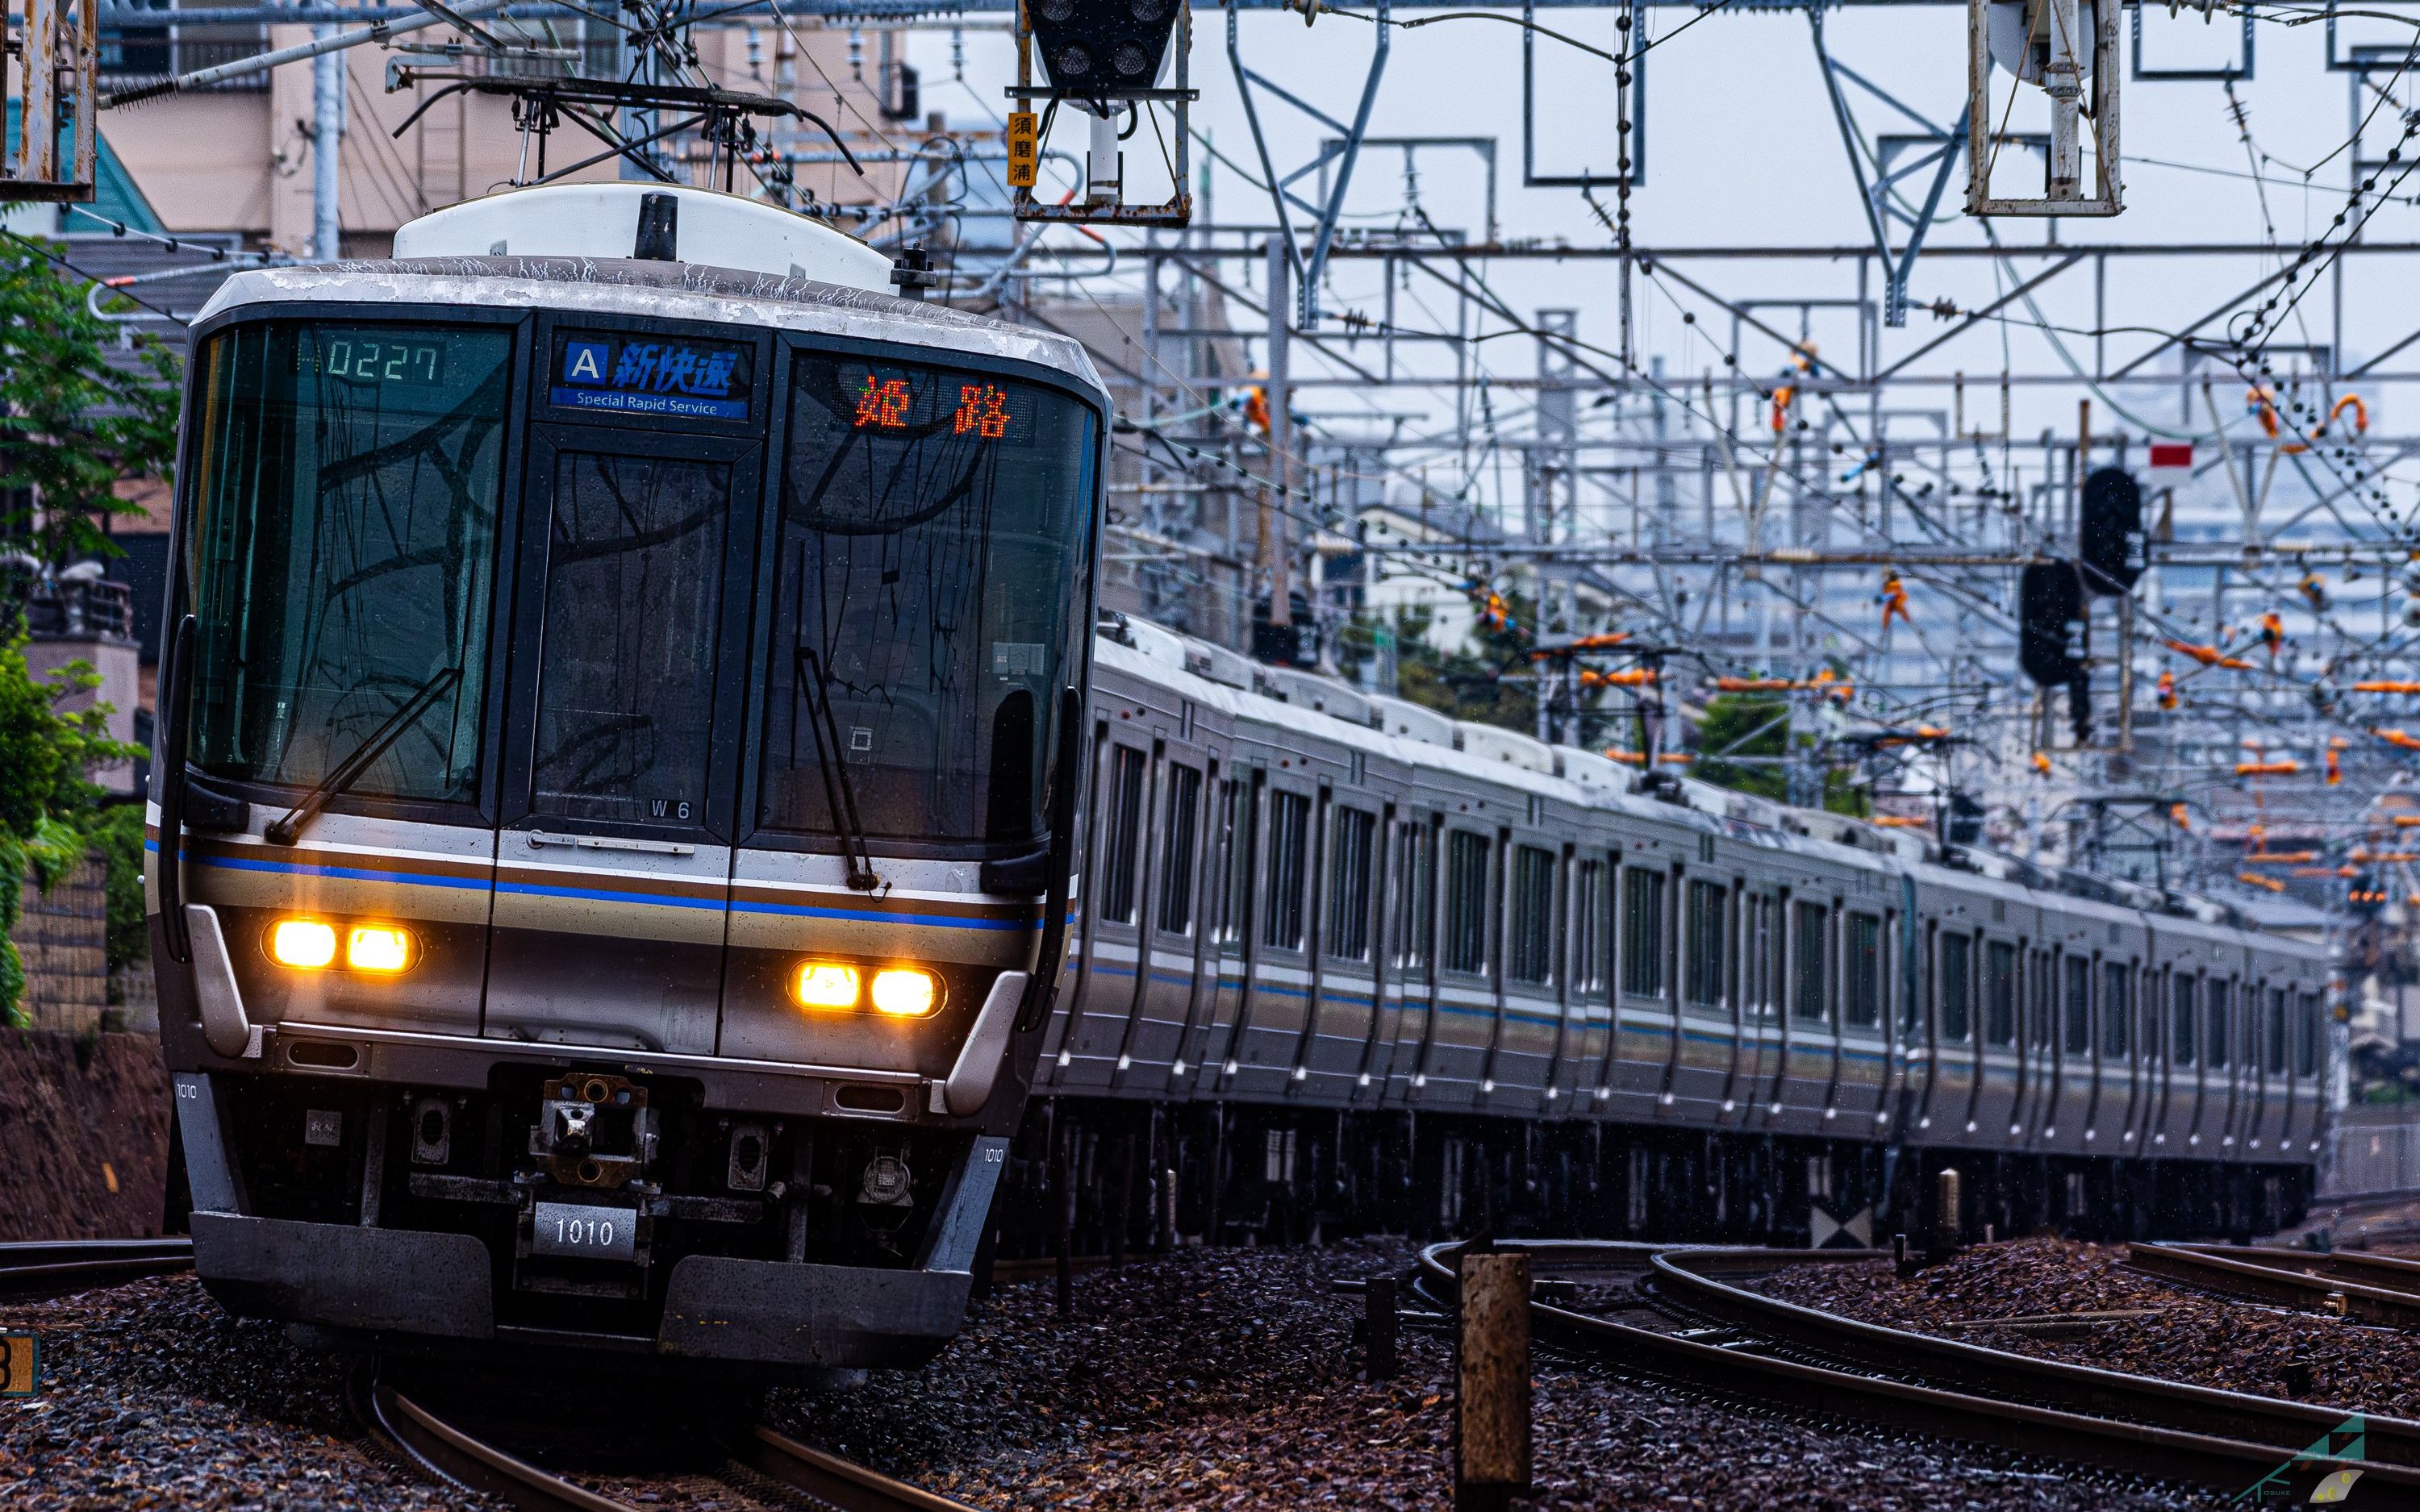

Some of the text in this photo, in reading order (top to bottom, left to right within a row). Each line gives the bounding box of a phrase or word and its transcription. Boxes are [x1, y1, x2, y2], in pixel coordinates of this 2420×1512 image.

[1013, 117, 1032, 181] 須磨浦
[328, 340, 437, 380] 0227
[571, 348, 599, 379] A
[611, 342, 737, 397] 新快速
[577, 392, 717, 414] Special Rapid Service
[652, 799, 690, 819] W 6
[177, 1083, 197, 1099] 1010
[984, 1148, 1003, 1163] 1010
[557, 1218, 613, 1246] 1010
